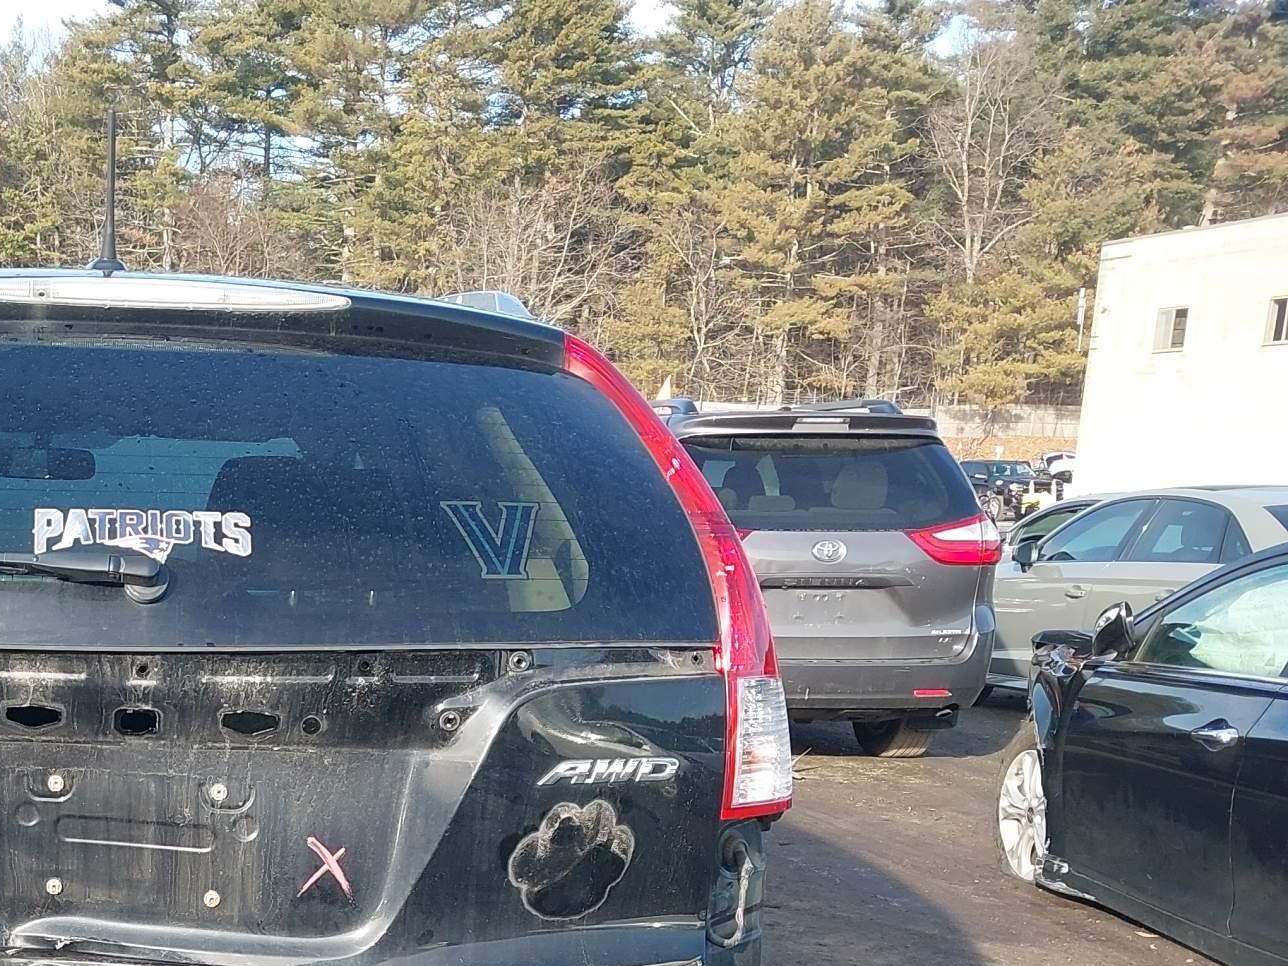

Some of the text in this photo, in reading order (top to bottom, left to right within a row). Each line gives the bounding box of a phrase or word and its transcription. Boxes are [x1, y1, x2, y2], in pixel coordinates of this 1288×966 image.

[32, 509, 252, 557] PATRIOTS
[440, 502, 540, 579] V
[536, 757, 680, 786] AWD
